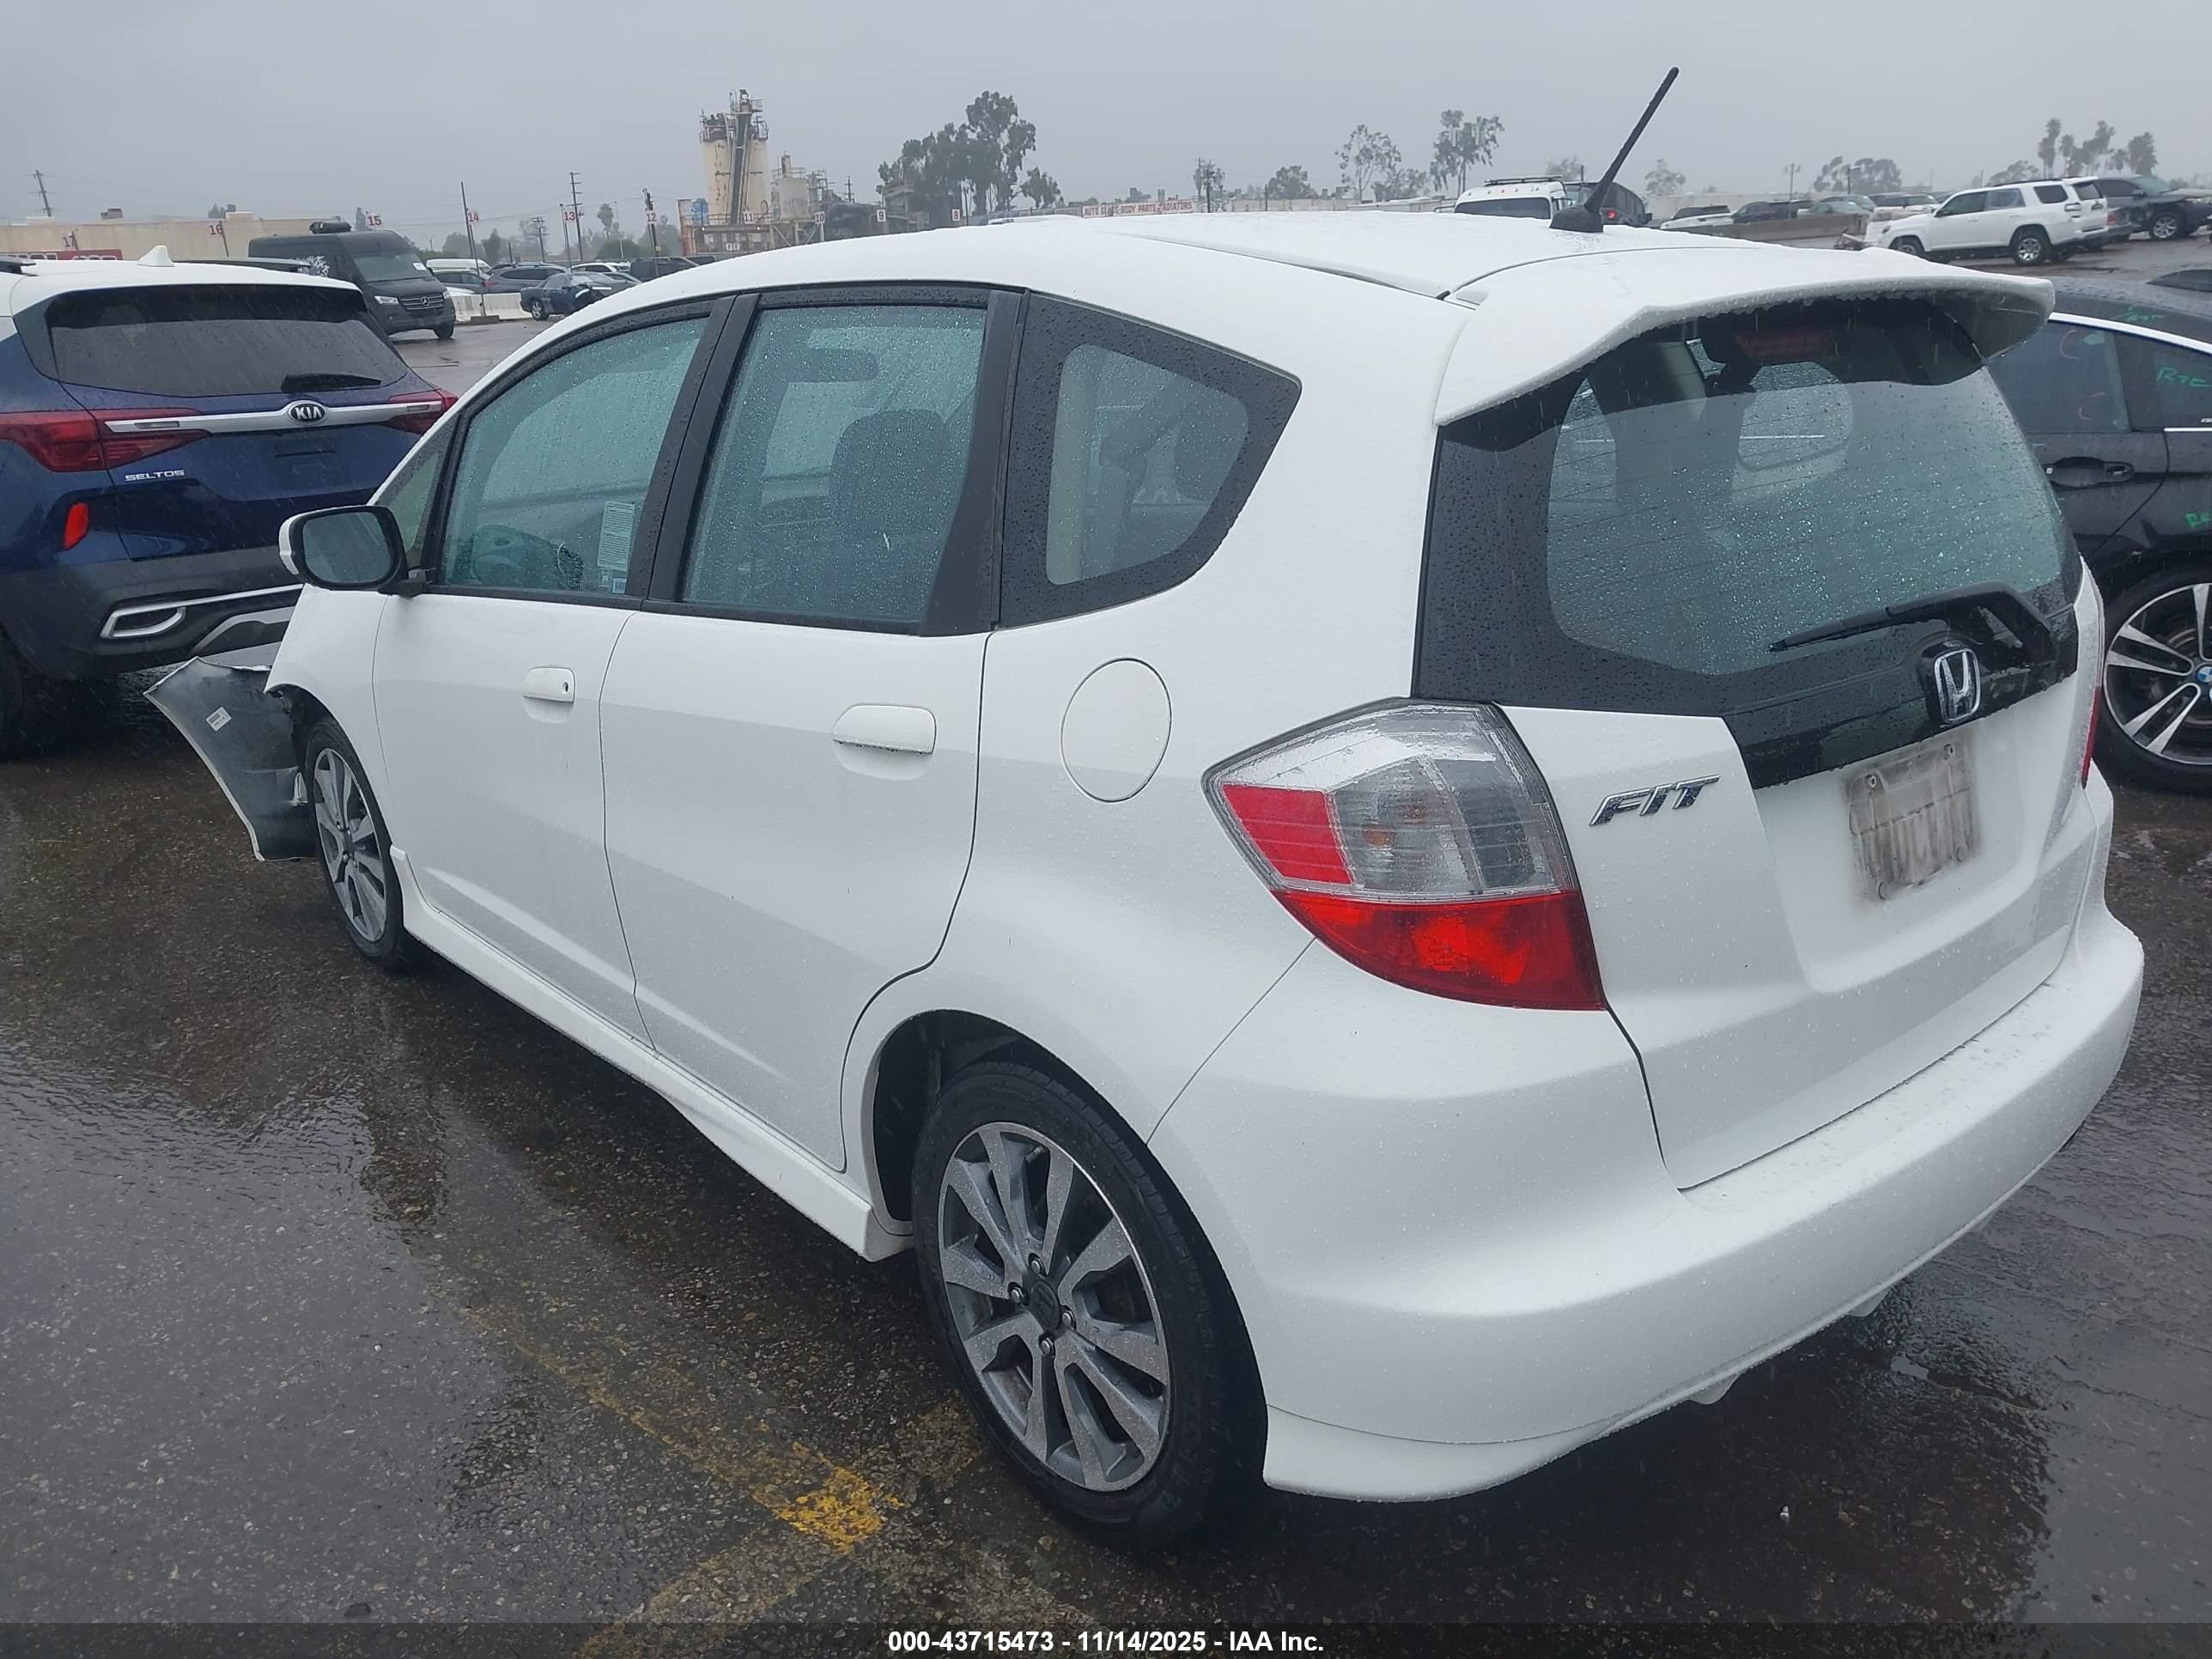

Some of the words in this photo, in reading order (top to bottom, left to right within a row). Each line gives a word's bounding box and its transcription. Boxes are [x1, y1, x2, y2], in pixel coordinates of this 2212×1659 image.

[469, 212, 479, 222] 14
[564, 211, 576, 221] 13
[647, 213, 656, 222] 12
[744, 213, 753, 222] 11
[878, 210, 884, 221] 9
[368, 216, 382, 226] 15
[210, 224, 223, 235] 16
[295, 406, 324, 420] KIA
[125, 470, 185, 482] SELTOS
[1589, 774, 1721, 827] FIT
